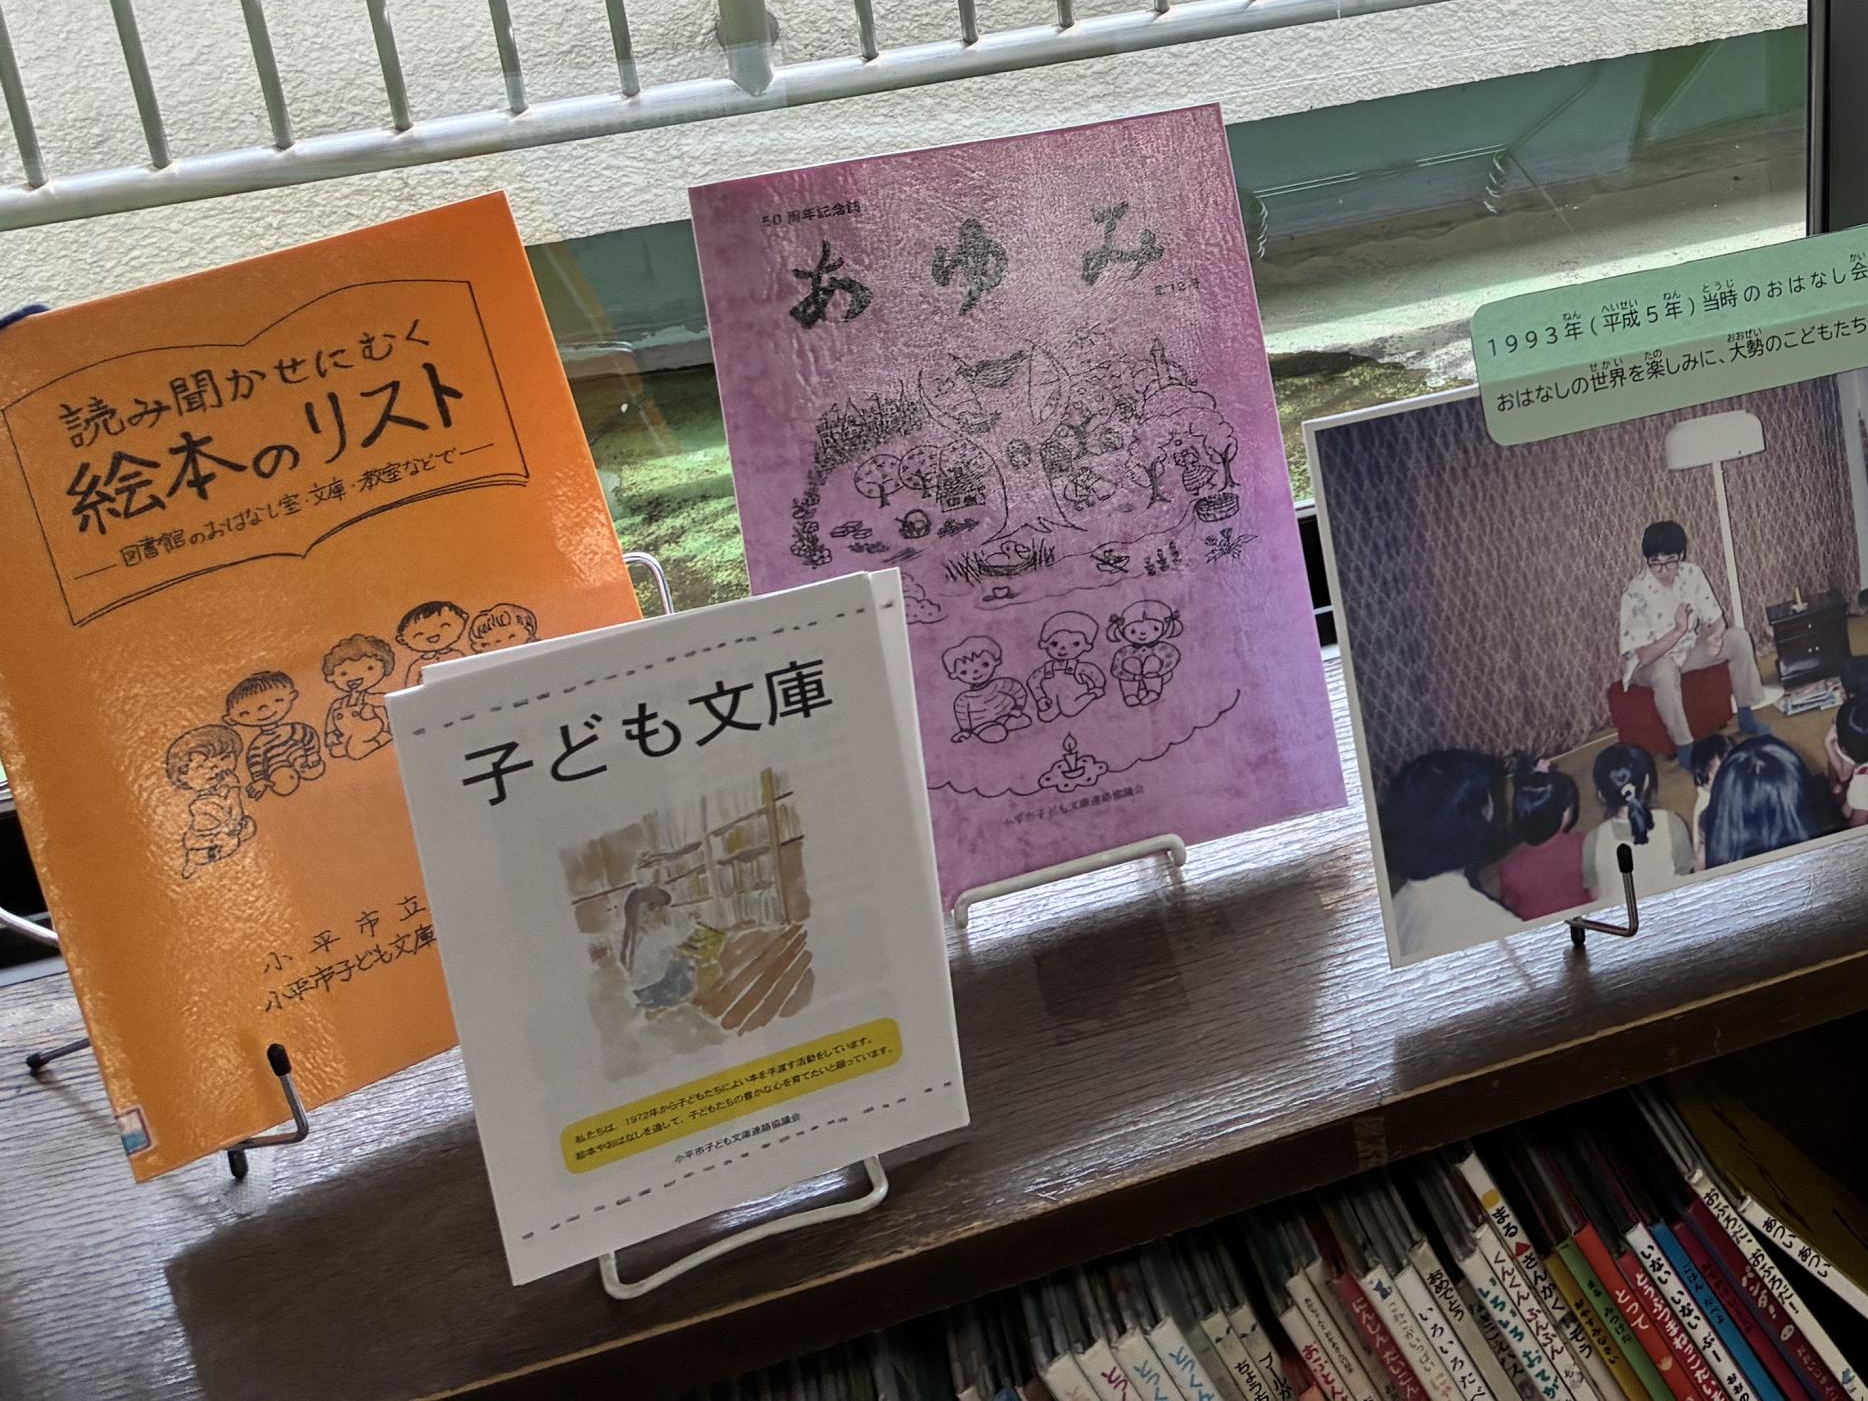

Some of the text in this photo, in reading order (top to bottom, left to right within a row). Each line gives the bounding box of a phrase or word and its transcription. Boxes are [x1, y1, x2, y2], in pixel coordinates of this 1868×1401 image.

[58, 319, 431, 448] 読み聞かせにむく
[68, 361, 464, 535] 絵本のリスト
[462, 659, 833, 806] 子ども文庫
[265, 924, 437, 1011] 小平市子ども文庫
[1491, 1206, 1592, 1359] まる さんかく ぞう
[1494, 1251, 1530, 1307] くんくん
[1641, 1245, 1671, 1285] いない
[1670, 1291, 1701, 1331] いない
[1762, 1216, 1831, 1279] あつい あつい
[1427, 1269, 1465, 1322] おめでとう
[1614, 1289, 1649, 1331] とって
